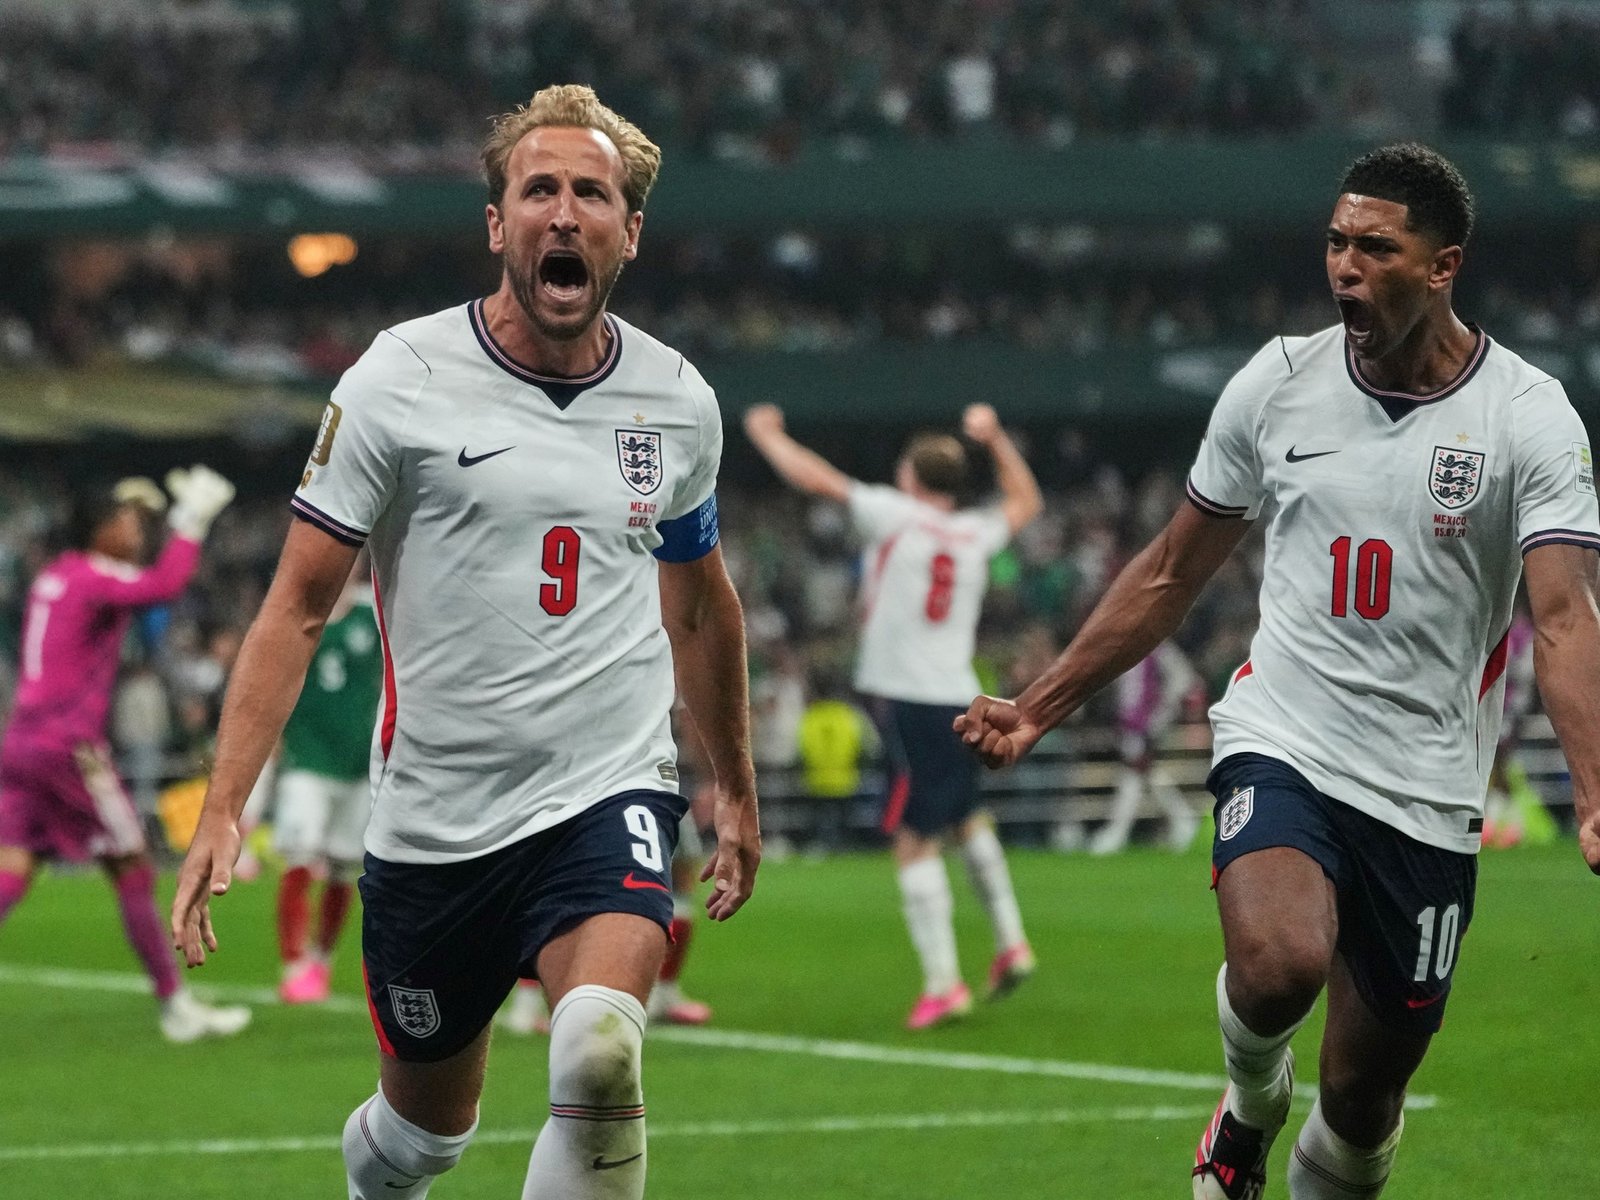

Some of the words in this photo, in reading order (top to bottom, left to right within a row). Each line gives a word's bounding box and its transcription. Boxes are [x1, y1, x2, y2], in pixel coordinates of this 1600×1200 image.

[1433, 513, 1467, 526] MEXICO
[539, 525, 581, 616] 9
[1329, 535, 1393, 620] 10
[623, 804, 664, 873] 9
[1414, 903, 1460, 982] 10
